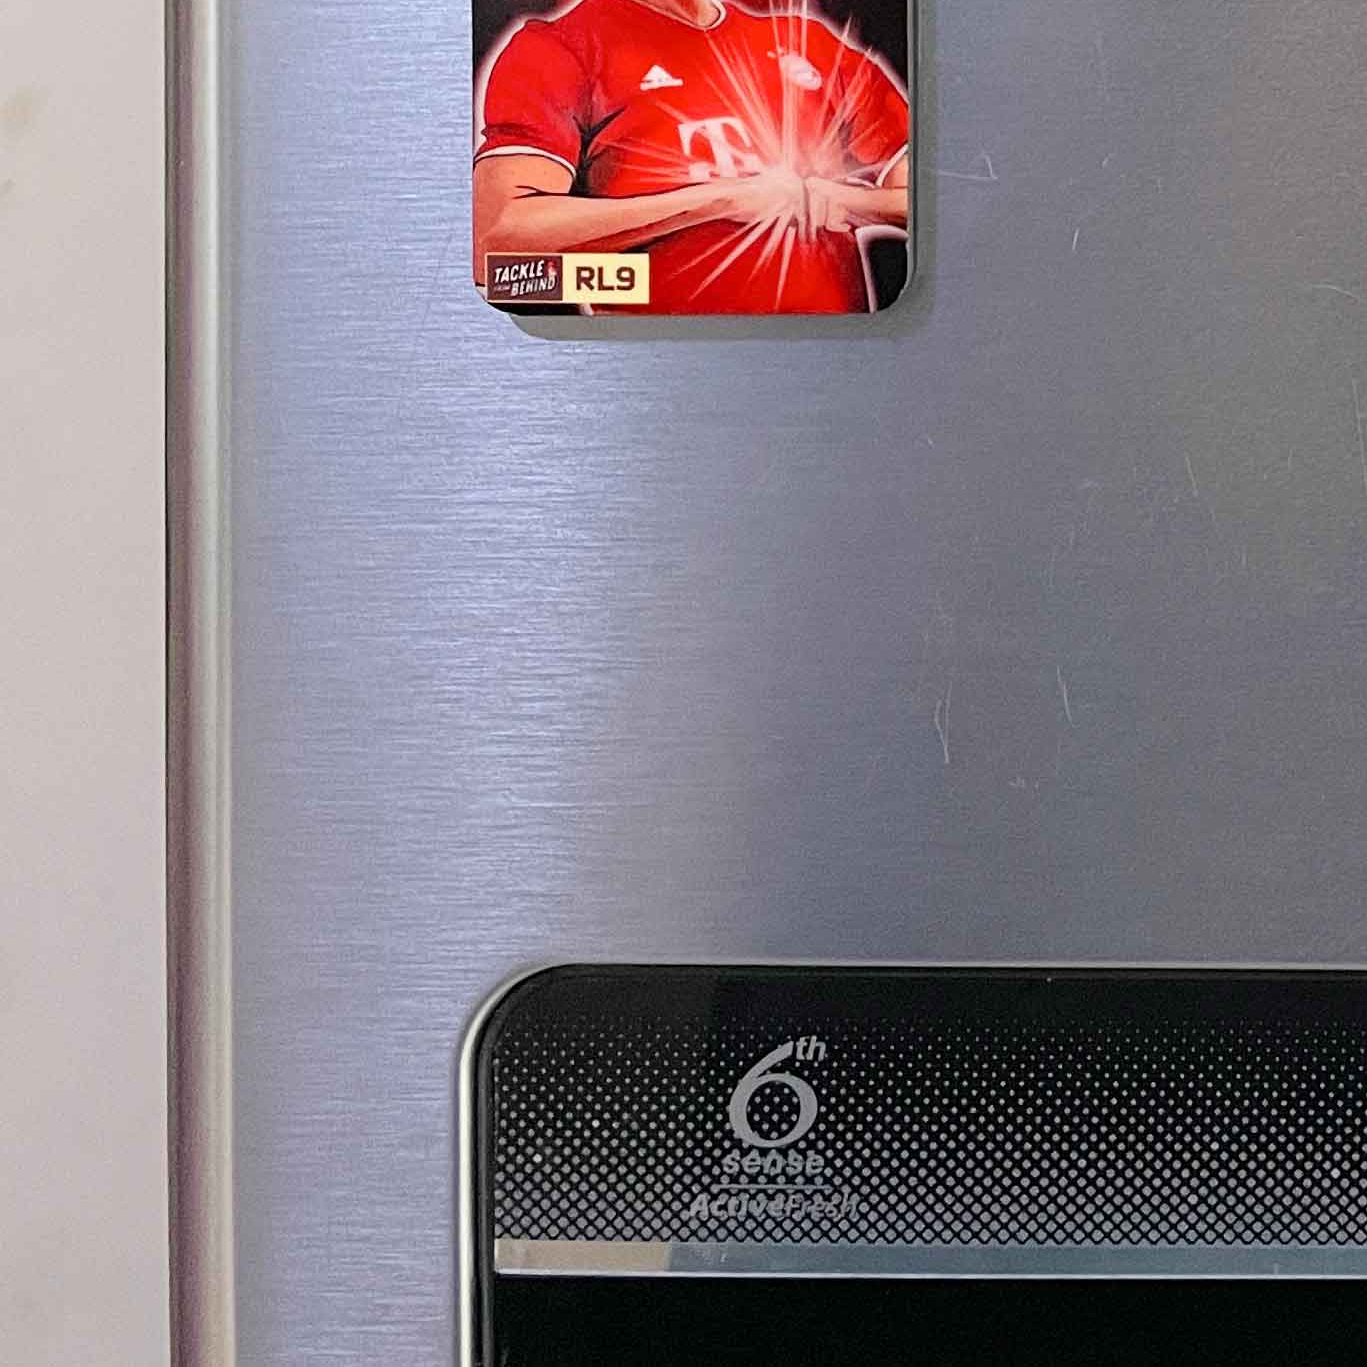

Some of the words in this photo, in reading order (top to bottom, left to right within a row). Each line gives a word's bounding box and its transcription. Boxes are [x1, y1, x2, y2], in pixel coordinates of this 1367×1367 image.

[495, 260, 545, 283] TACKLE
[576, 266, 636, 291] RL9
[510, 276, 557, 297] BEHIND
[722, 1148, 825, 1176] sense
